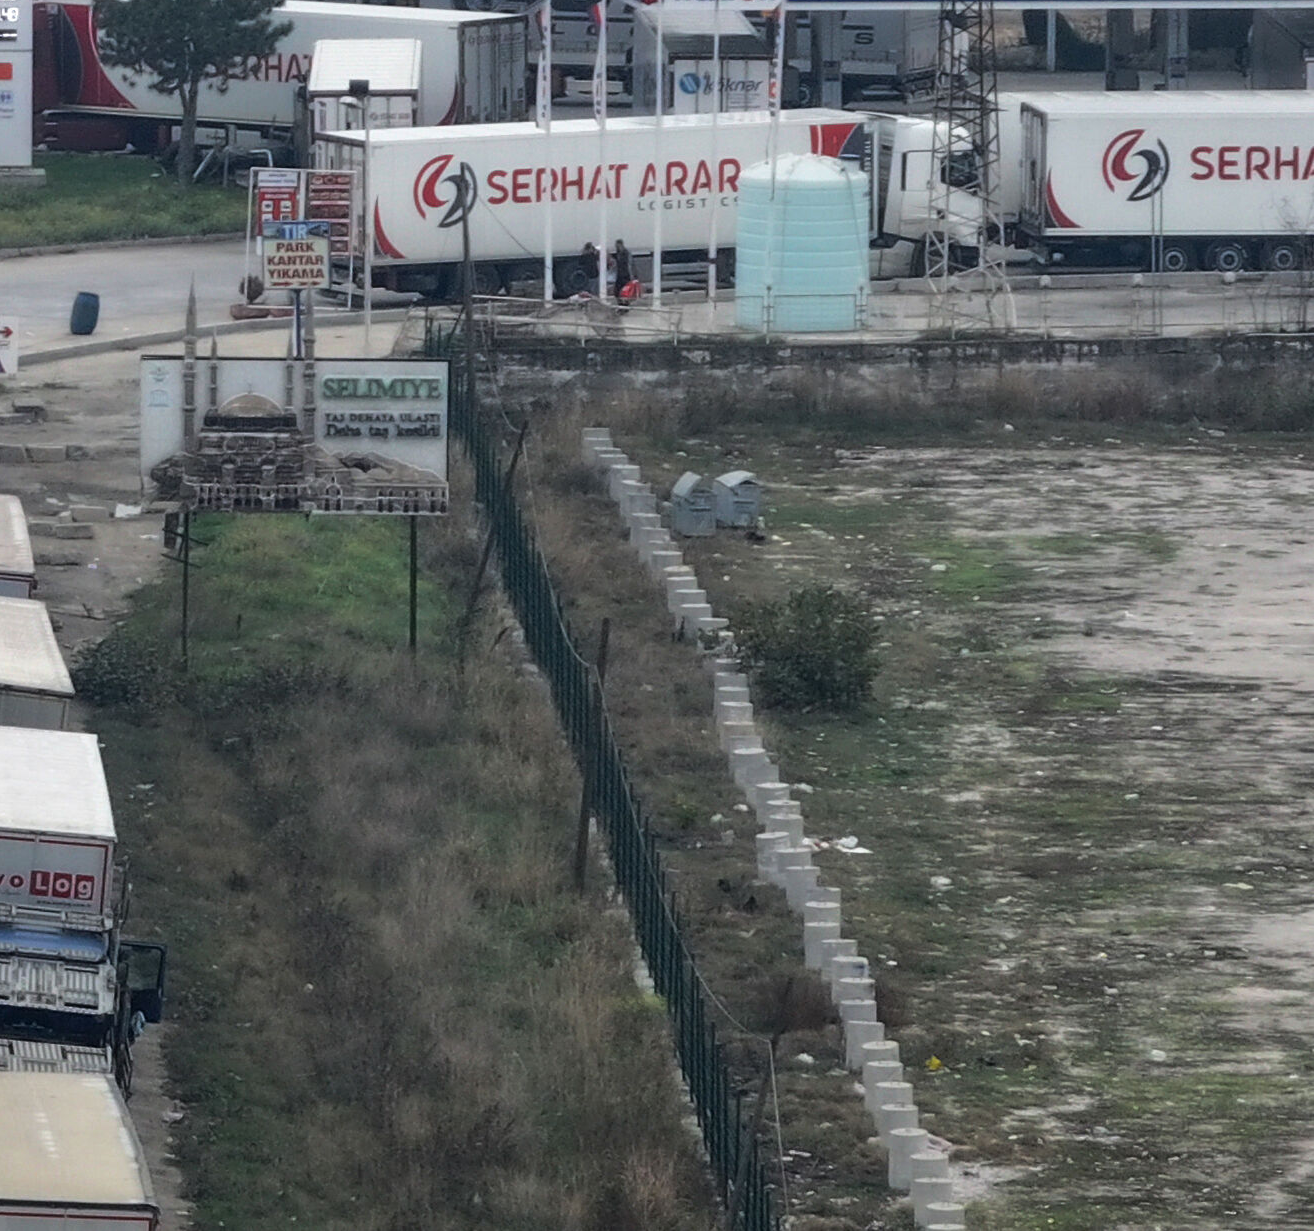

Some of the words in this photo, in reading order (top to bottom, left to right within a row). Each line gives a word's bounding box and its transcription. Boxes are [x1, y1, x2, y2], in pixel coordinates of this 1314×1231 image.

[487, 162, 630, 205] SERHAT
[638, 157, 742, 198] ARAR
[283, 223, 308, 240] TIR
[276, 242, 316, 252] PARK
[268, 255, 325, 266] KANTAR
[268, 269, 325, 279] YIKAMA
